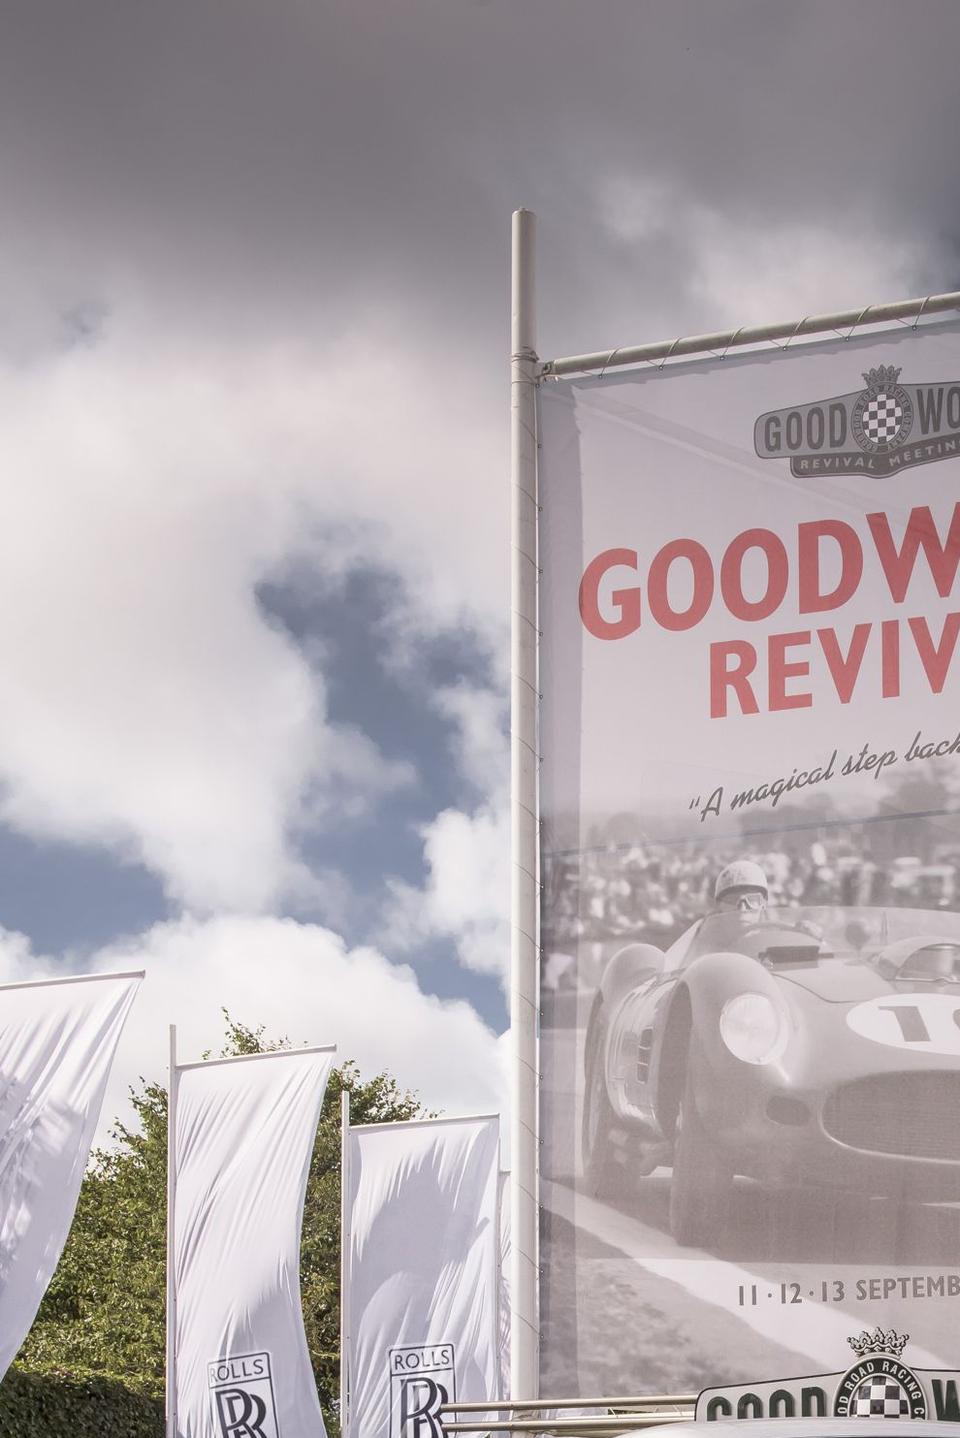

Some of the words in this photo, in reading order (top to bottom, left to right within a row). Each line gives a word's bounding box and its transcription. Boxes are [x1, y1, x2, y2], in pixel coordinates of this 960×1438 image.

[764, 402, 848, 451] GOOD
[800, 457, 875, 470] REVIVAL
[730, 749, 838, 811] magical
[841, 743, 899, 780] step
[210, 1358, 265, 1383] ROLLS
[394, 1350, 450, 1371] ROLLS
[844, 1361, 875, 1391] ROAD
[882, 1360, 922, 1400] RACING
